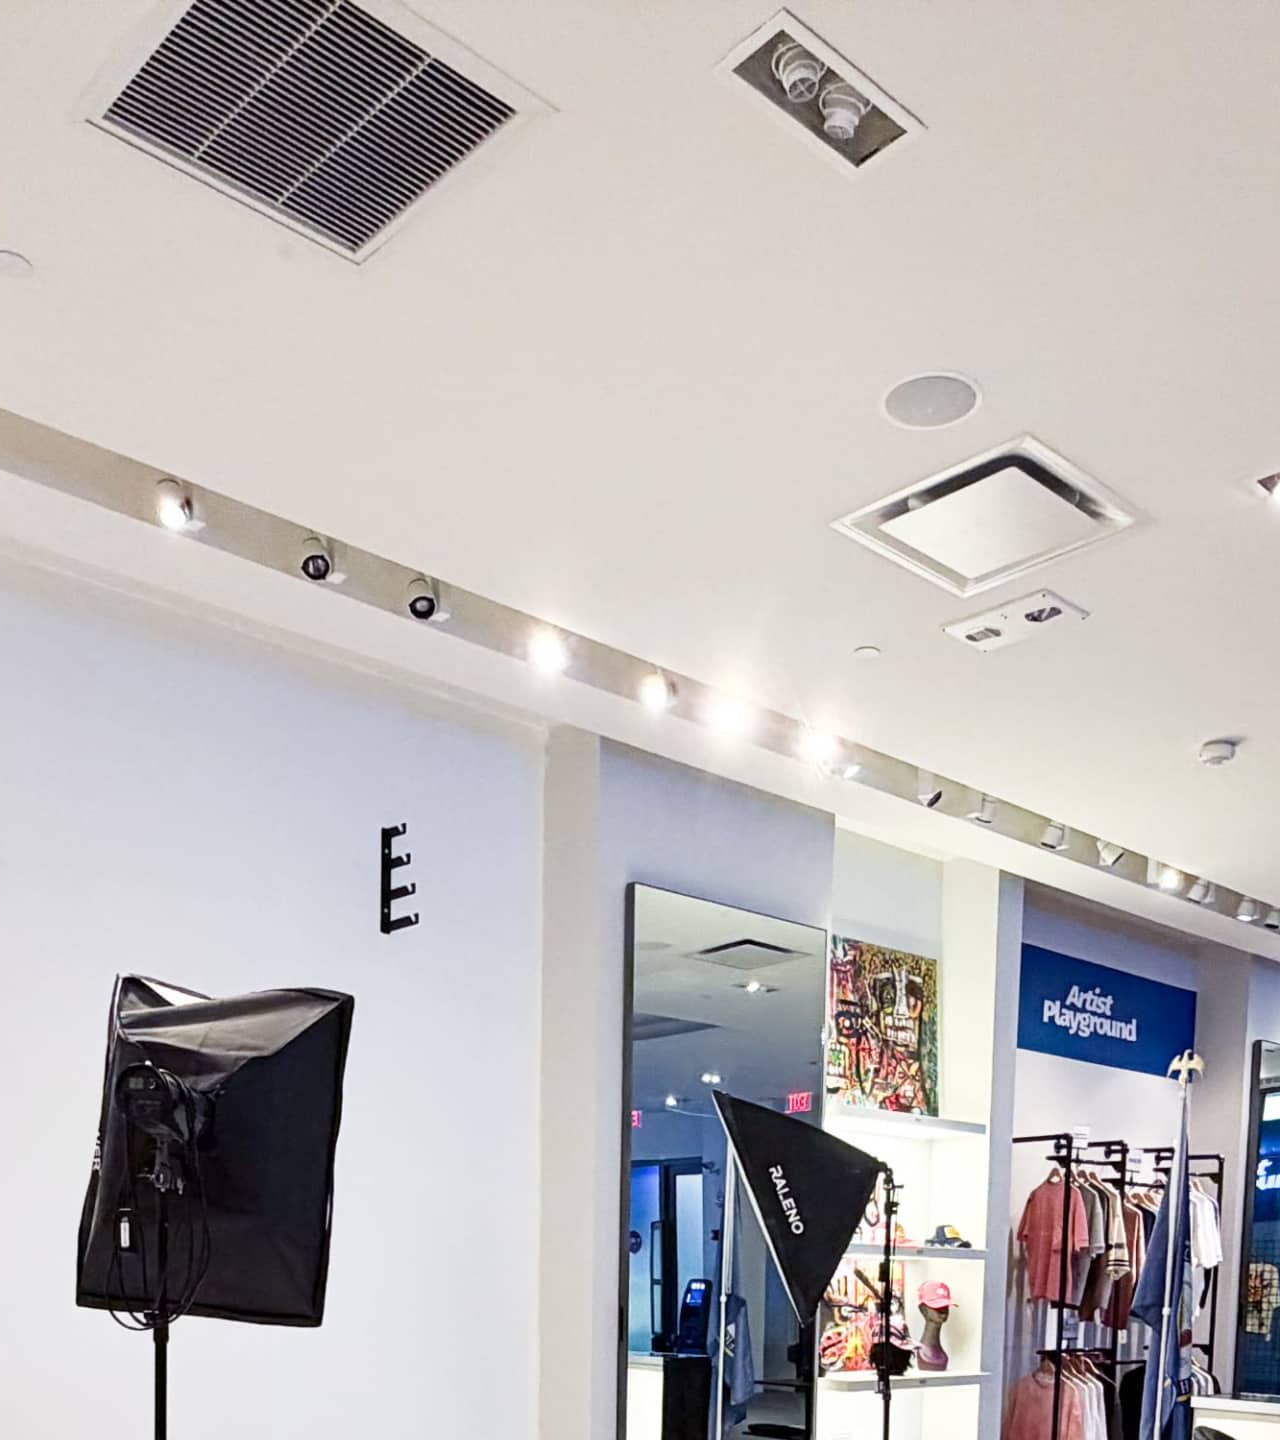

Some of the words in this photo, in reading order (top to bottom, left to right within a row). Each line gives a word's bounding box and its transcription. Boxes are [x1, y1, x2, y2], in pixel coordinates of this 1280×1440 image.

[1043, 1000, 1137, 1042] Playground
[1066, 985, 1114, 1016] Artist
[768, 1164, 805, 1235] RALENO
